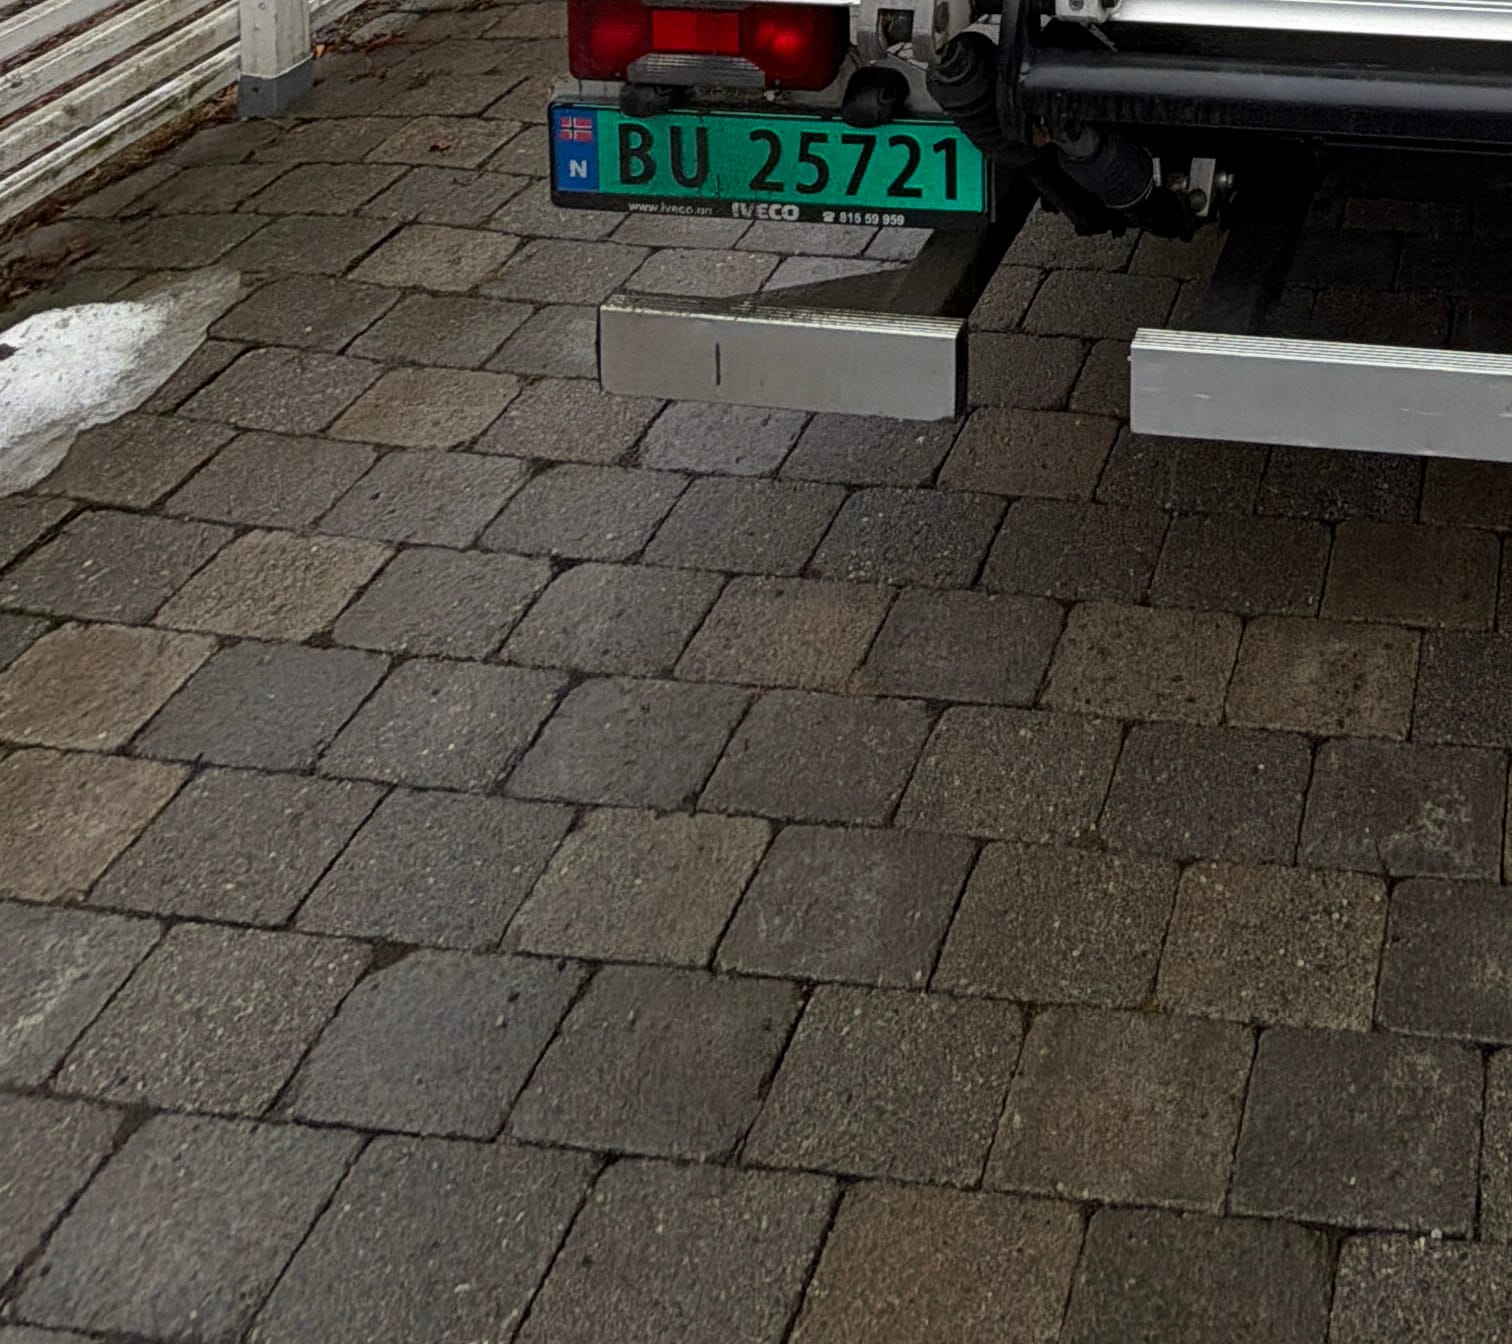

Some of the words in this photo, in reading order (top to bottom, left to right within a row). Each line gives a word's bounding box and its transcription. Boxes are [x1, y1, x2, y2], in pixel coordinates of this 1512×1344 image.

[569, 158, 588, 179] N
[617, 123, 709, 188] BU
[748, 129, 959, 200] 25721
[731, 202, 800, 221] IVECO
[864, 213, 880, 224] 59
[882, 214, 905, 226] 959
